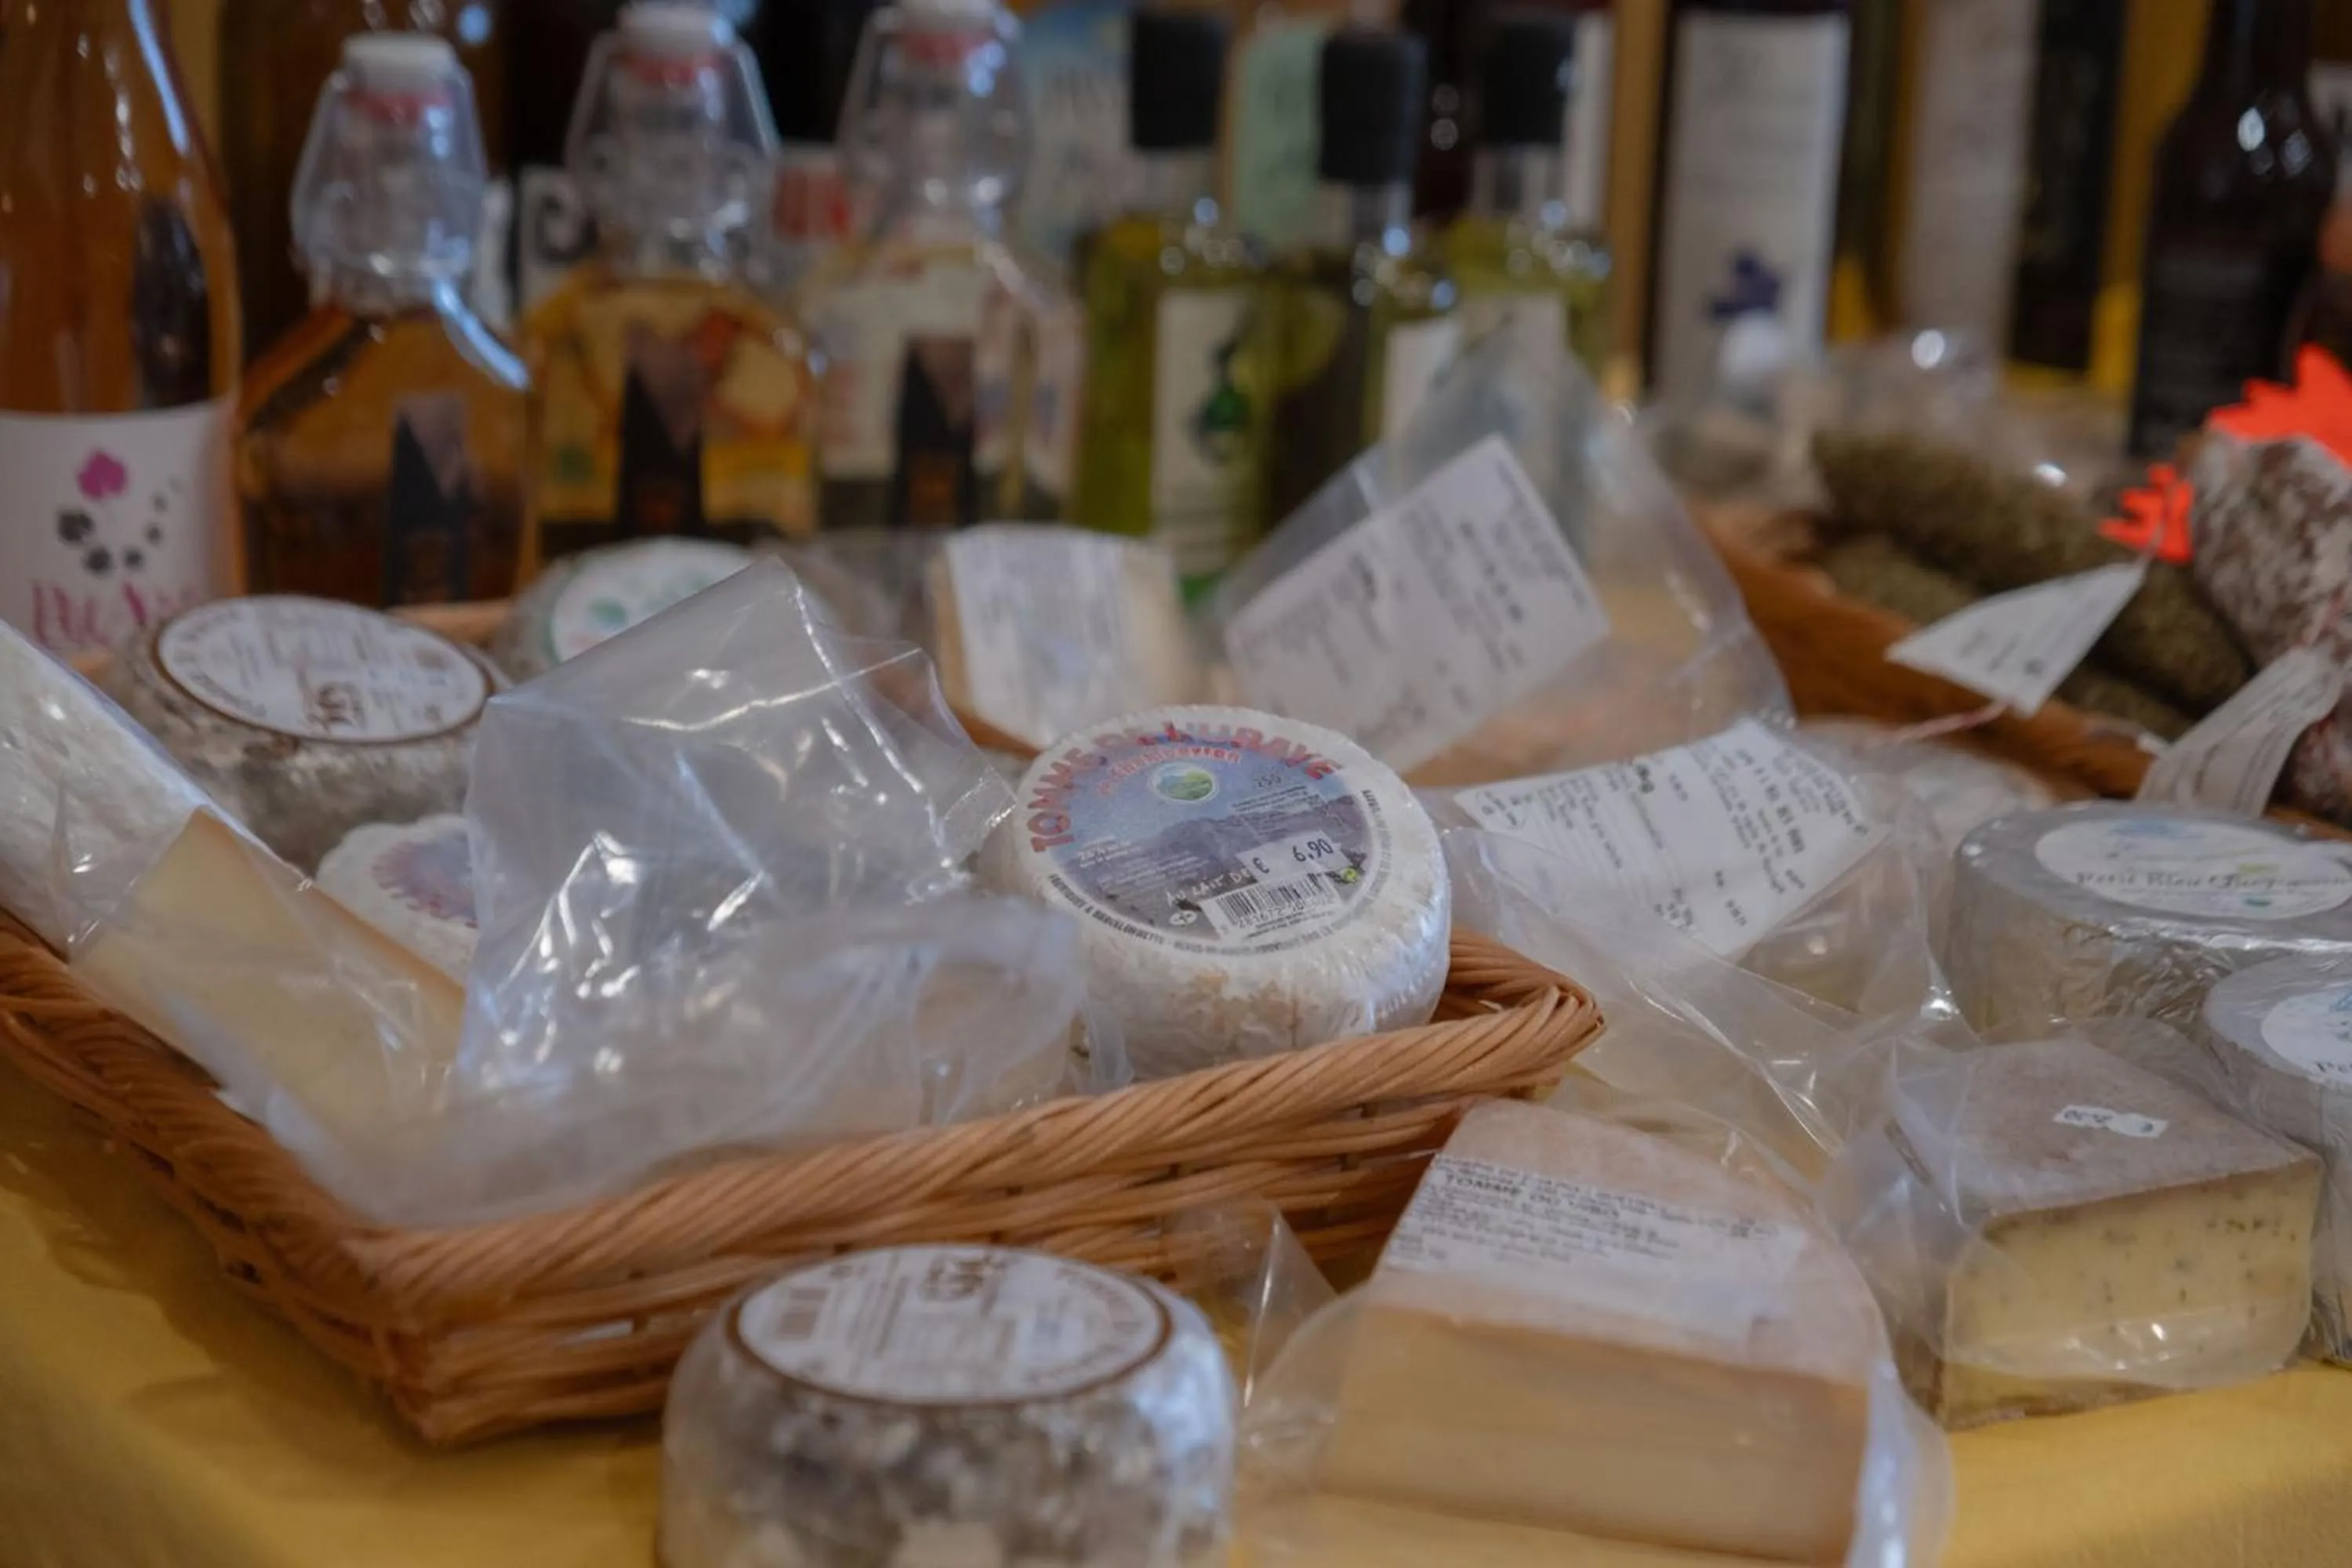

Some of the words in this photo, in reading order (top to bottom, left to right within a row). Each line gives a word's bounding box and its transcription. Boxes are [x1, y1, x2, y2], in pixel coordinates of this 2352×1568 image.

[1026, 747, 1109, 854] TOMME
[1251, 857, 1271, 874] €
[1292, 837, 1334, 862] 6,90
[1192, 876, 1225, 897] LAIT
[1229, 867, 1252, 884] DE
